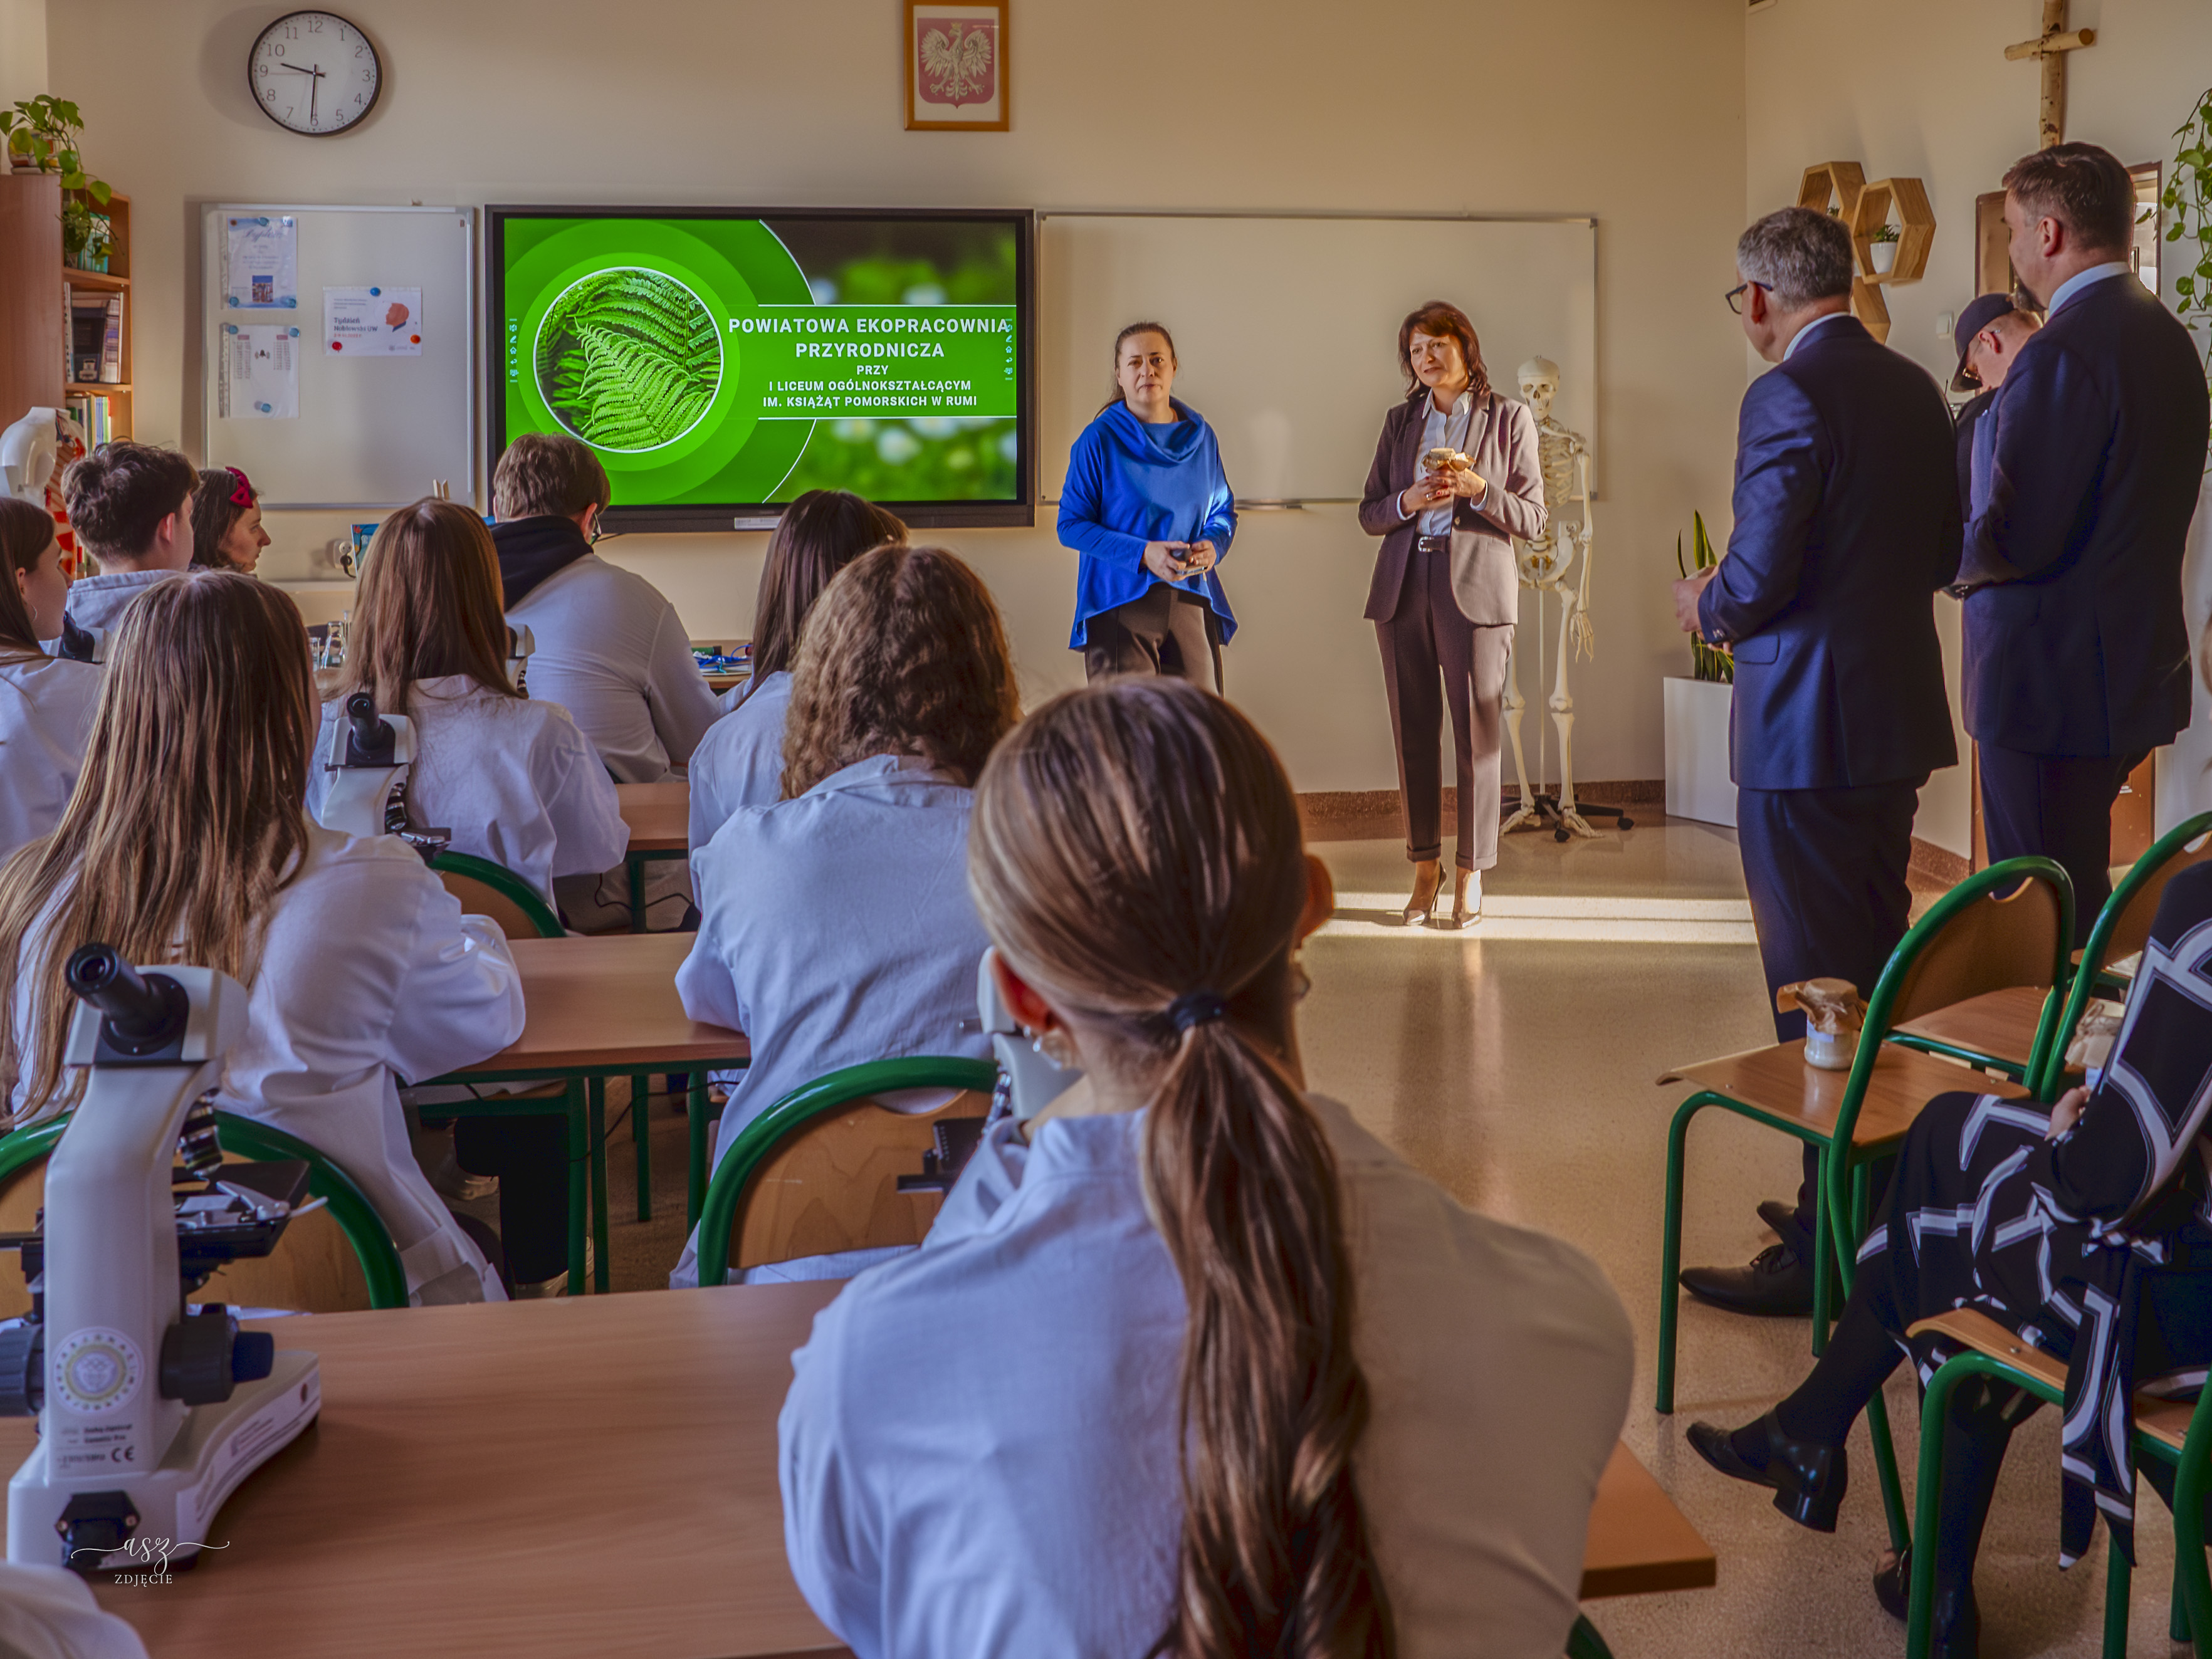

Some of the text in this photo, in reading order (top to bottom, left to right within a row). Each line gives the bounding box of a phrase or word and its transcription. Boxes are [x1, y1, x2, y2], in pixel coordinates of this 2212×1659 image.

[285, 26, 299, 39] 11
[307, 19, 323, 33] 12
[339, 28, 345, 41] 1
[267, 43, 285, 57] 10
[354, 45, 363, 58] 2
[259, 65, 268, 78] 9
[362, 69, 371, 82] 3
[266, 88, 276, 102] 8
[354, 93, 362, 105] 4
[286, 106, 295, 119] 7
[335, 108, 344, 122] 5
[310, 113, 319, 127] 6
[729, 318, 1009, 333] POWIATOWA EKOPRACOWNIA
[796, 343, 945, 357] PRZYRODNICZA
[856, 365, 889, 375] PRZY
[769, 379, 971, 393] I LICEUM OGÓLNOKSZTAŁCĄCYM
[763, 395, 977, 409] IM. KSIĄŻĄT POMORSKICH W RUMI
